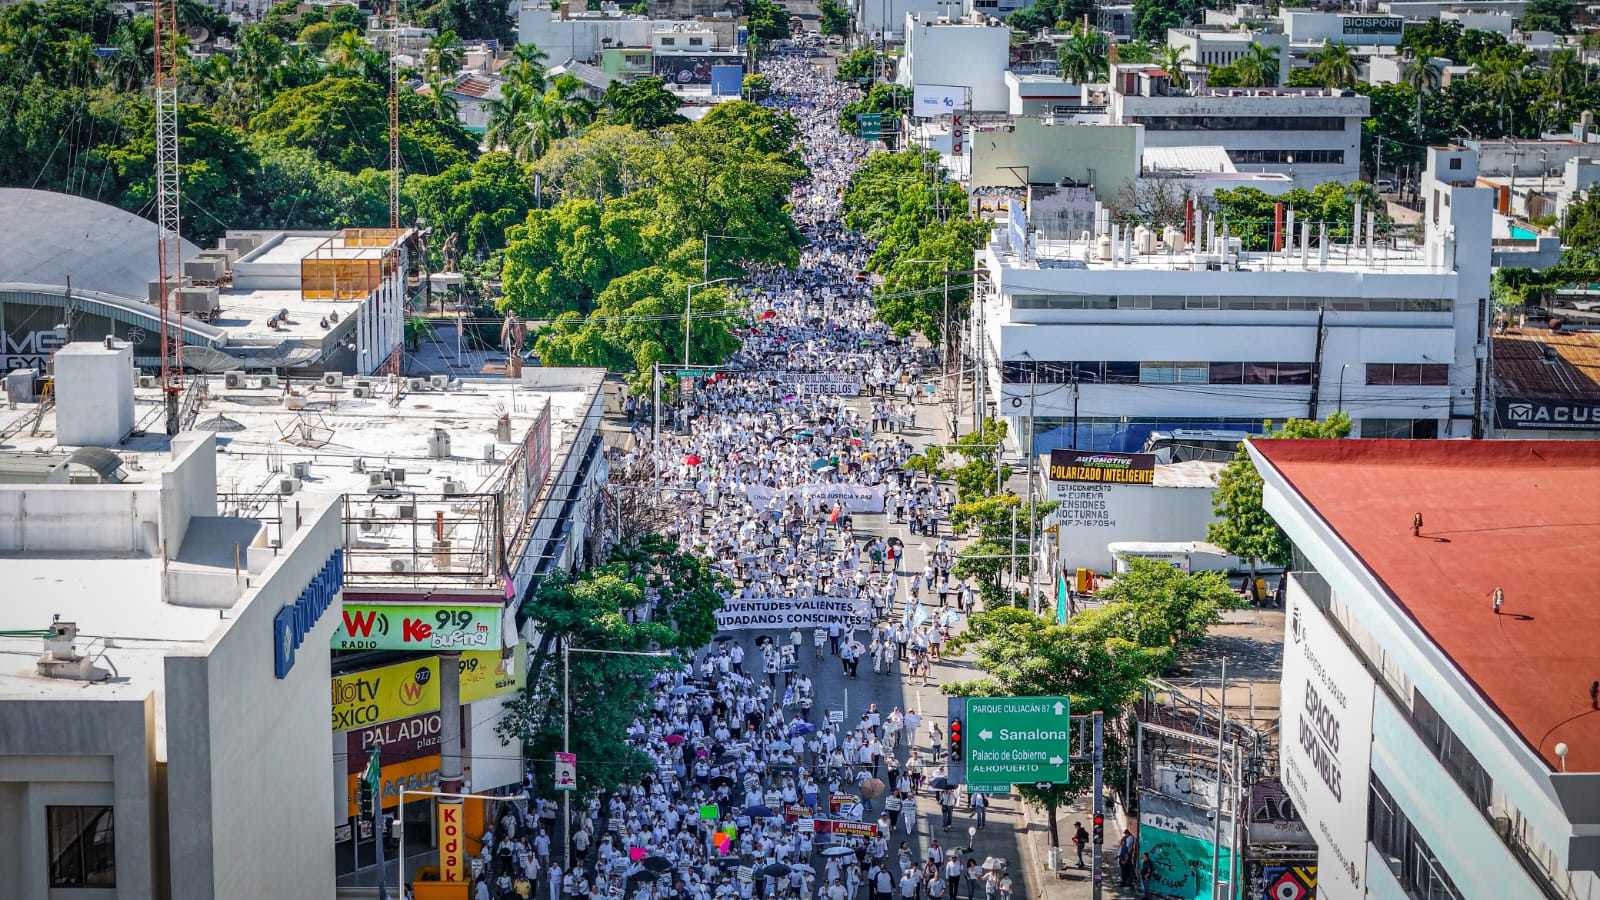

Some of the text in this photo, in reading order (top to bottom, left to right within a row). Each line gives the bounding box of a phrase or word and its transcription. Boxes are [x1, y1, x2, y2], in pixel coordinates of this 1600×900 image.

[1343, 17, 1402, 28] BICISPORT
[819, 384, 830, 394] DE
[830, 384, 853, 394] ELLOS
[1074, 455, 1133, 465] AUTOMOTIVE
[1050, 465, 1154, 484] POLARIZADO INTELIGENTE
[1057, 484, 1112, 492] ESTACIONAMIENTO
[1068, 492, 1104, 500] EUREKA
[1056, 509, 1109, 519] NOCTURNAS
[719, 600, 857, 614] JUVENTUDES VALIENTES,
[342, 610, 377, 638] W
[402, 617, 432, 643] Ke
[476, 622, 488, 632] fm
[341, 640, 377, 649] RADIO
[430, 628, 489, 649] buena
[972, 702, 1050, 714] PARQUE CULIACÁN 87
[1305, 678, 1340, 754] ESPACIOS
[362, 714, 441, 750] PALADIO
[999, 728, 1067, 741] Sanalona
[416, 734, 441, 750] plaza
[972, 748, 1047, 761] Palacio de Gobierno
[1299, 711, 1342, 804] DISPONIBLES
[973, 764, 1039, 773] AEROPUERTO
[443, 808, 458, 882] Kodak
